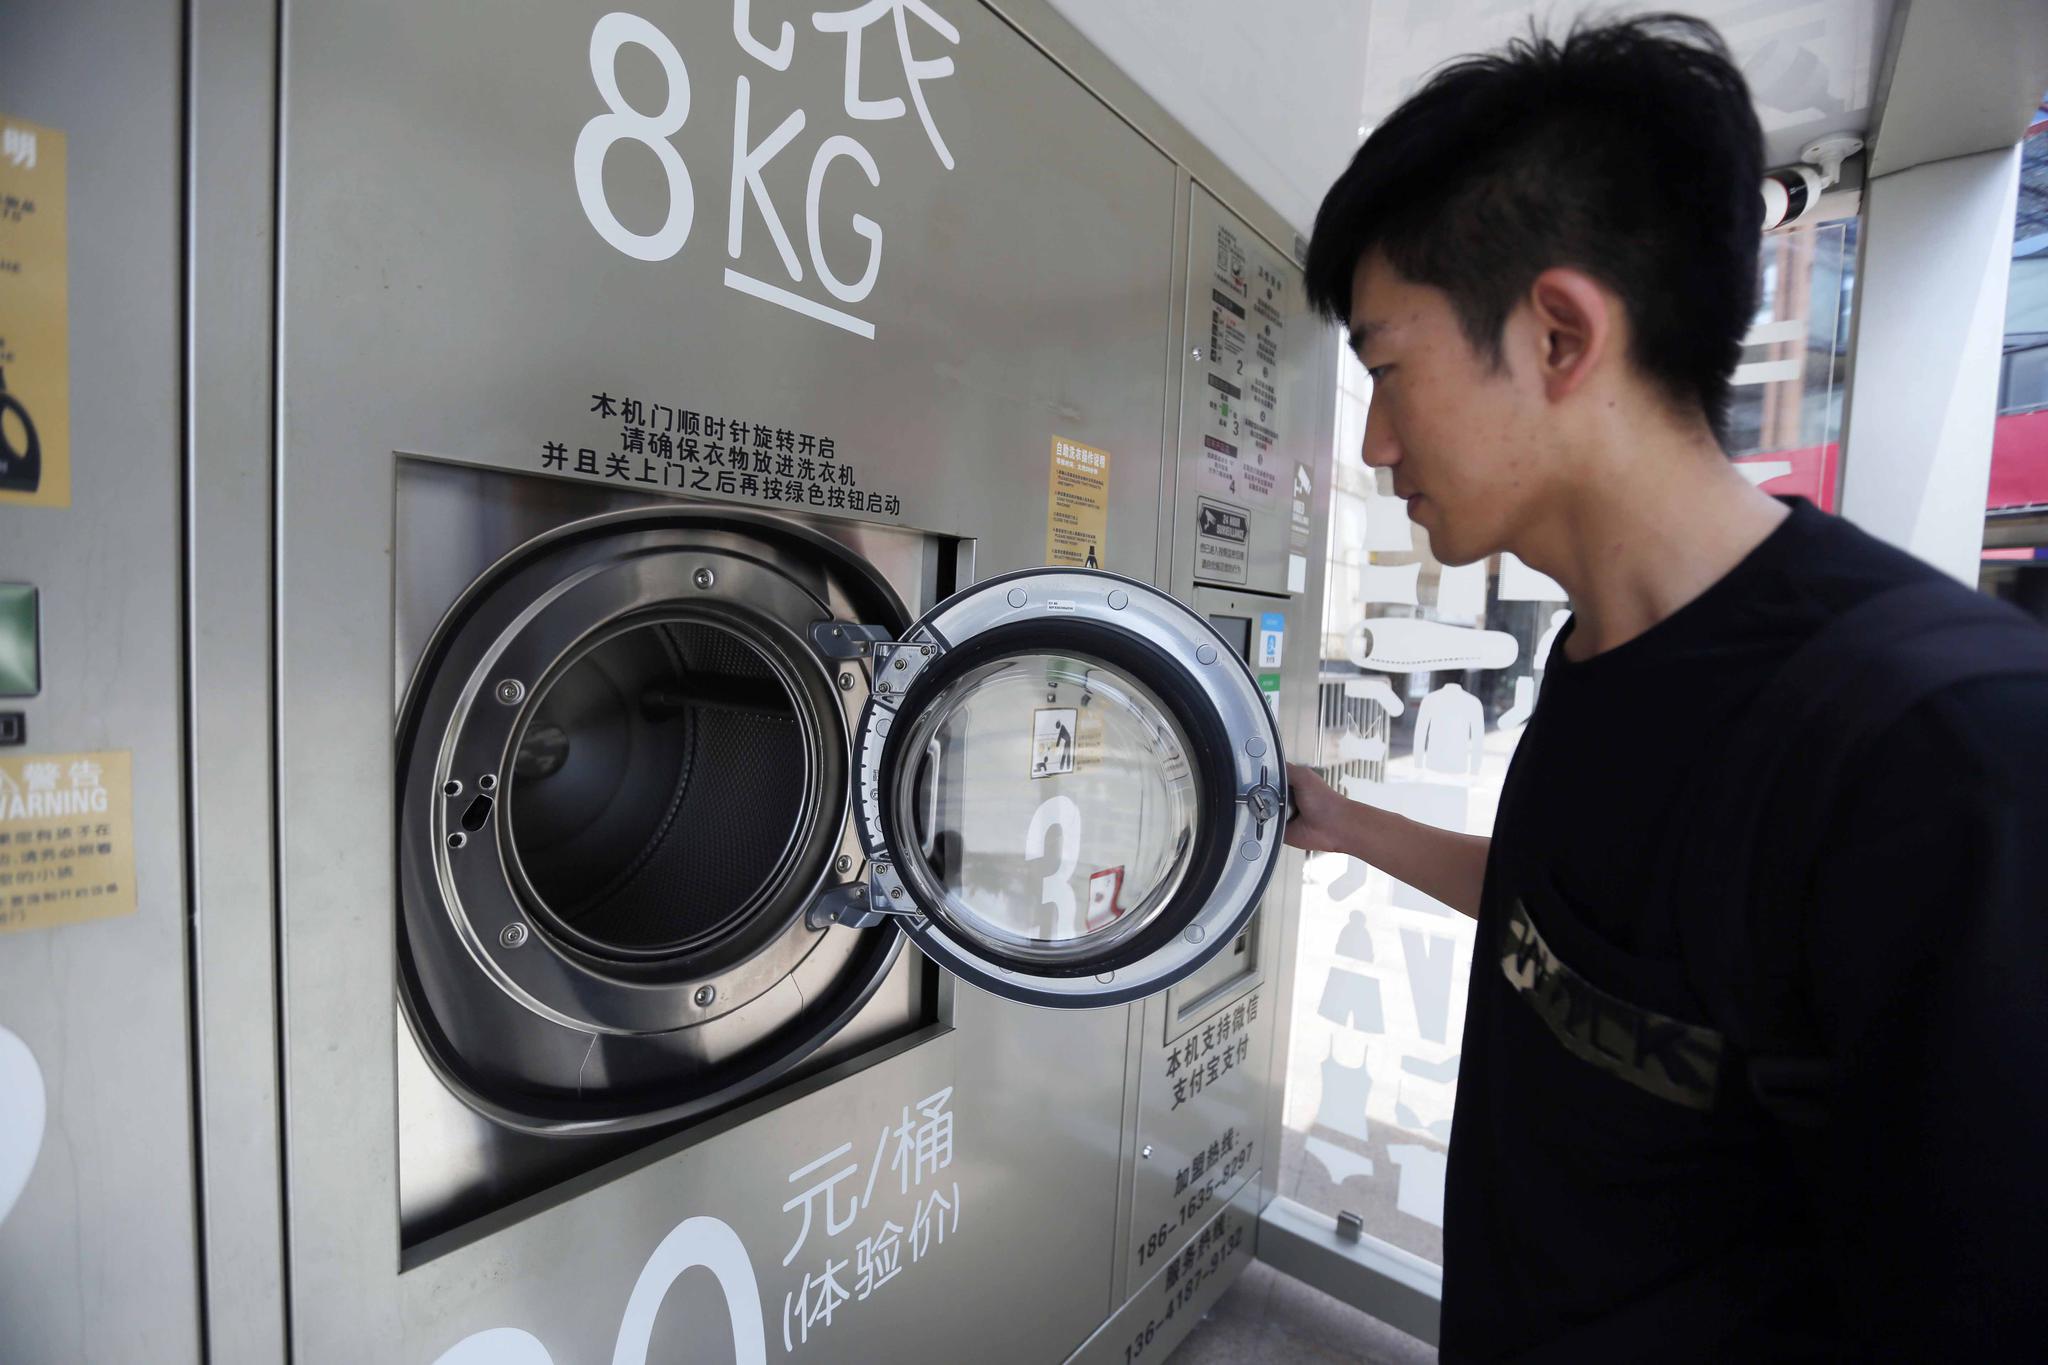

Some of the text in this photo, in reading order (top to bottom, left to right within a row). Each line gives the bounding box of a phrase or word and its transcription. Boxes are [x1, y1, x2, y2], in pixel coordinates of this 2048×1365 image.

[573, 12, 883, 303] 8 KG
[590, 392, 835, 460] 本机门顺时针旋转开启
[620, 426, 856, 487] 请确保衣物放进洗衣机
[541, 441, 901, 517] 并且关上门之后再按绿色按钮启动
[1165, 994, 1260, 1078] 本机支持微信
[1171, 1033, 1249, 1111] 支付宝支付
[783, 1086, 954, 1267] 元/桶
[783, 1182, 960, 1352] (体验价)
